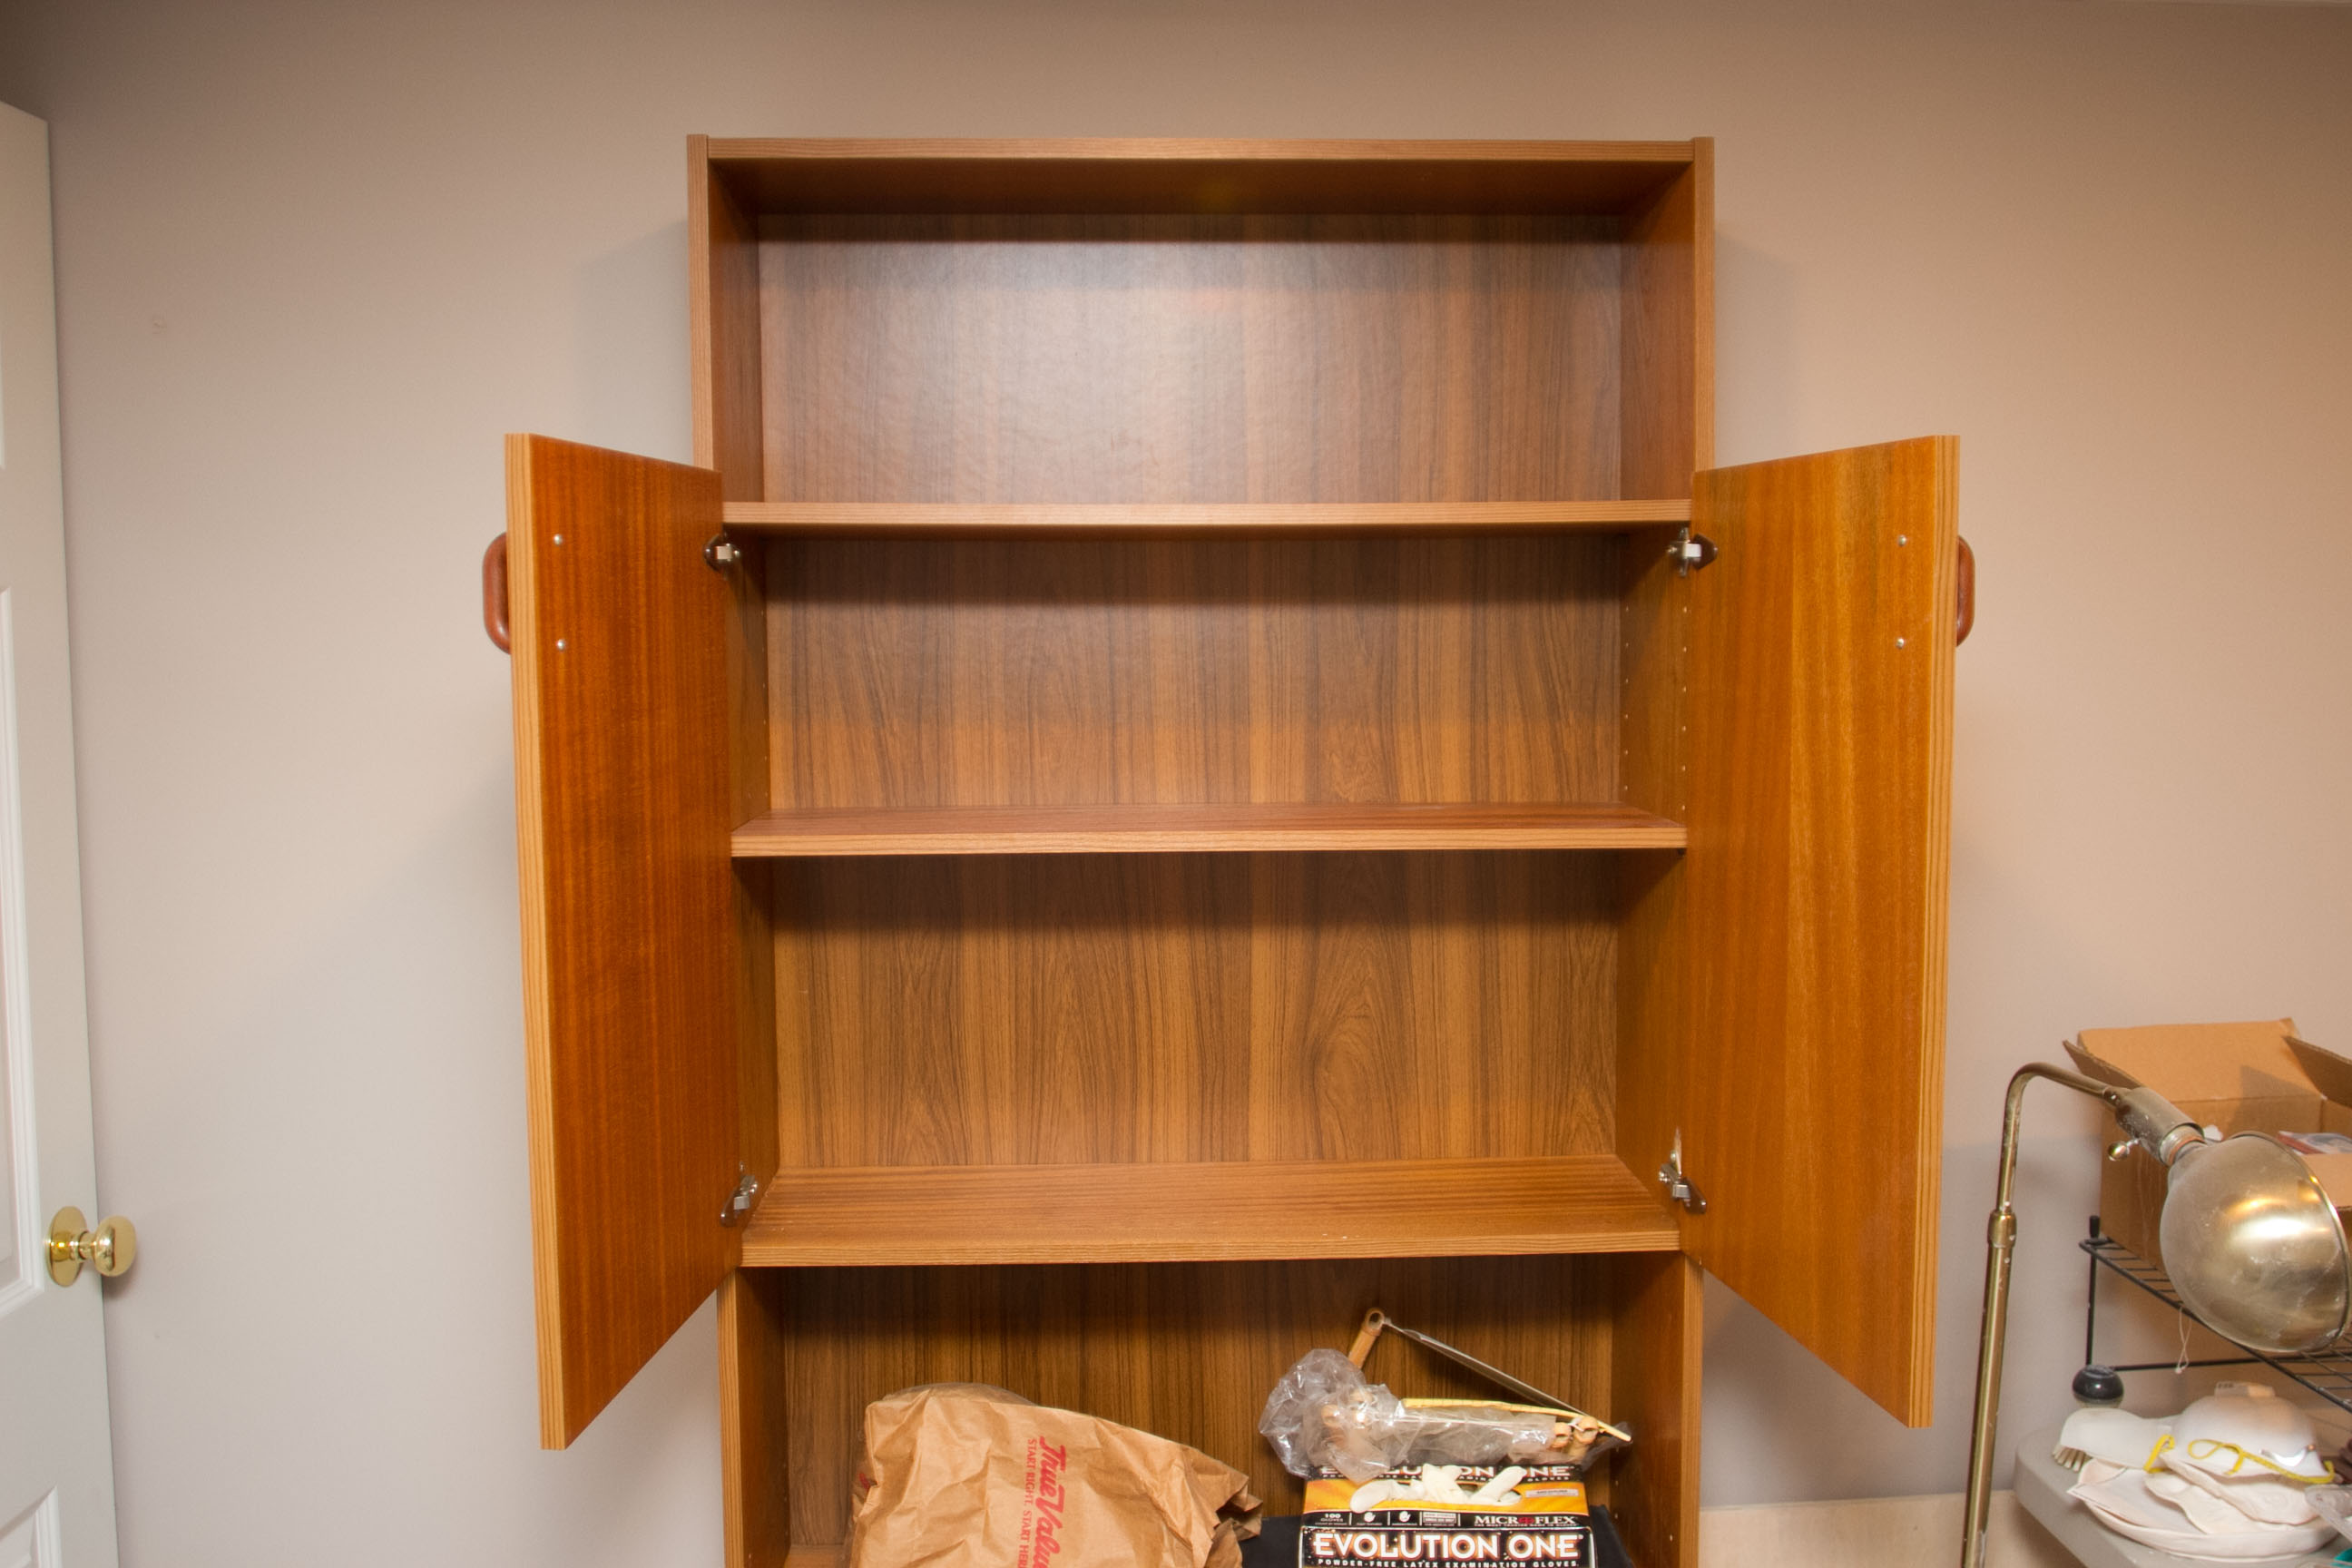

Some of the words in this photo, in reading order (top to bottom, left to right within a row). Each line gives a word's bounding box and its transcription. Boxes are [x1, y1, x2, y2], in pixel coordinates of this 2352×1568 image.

[1027, 1438, 1037, 1469] START
[1039, 1436, 1066, 1497] True
[1024, 1472, 1036, 1506] RIGHT.
[1021, 1510, 1033, 1542] START
[1018, 1544, 1030, 1568] HER
[1313, 1533, 1498, 1559] EVOLUTION
[1508, 1534, 1579, 1559] ONE
[1318, 1558, 1396, 1568] POWDER-FREE
[1403, 1560, 1438, 1568] LATEX
